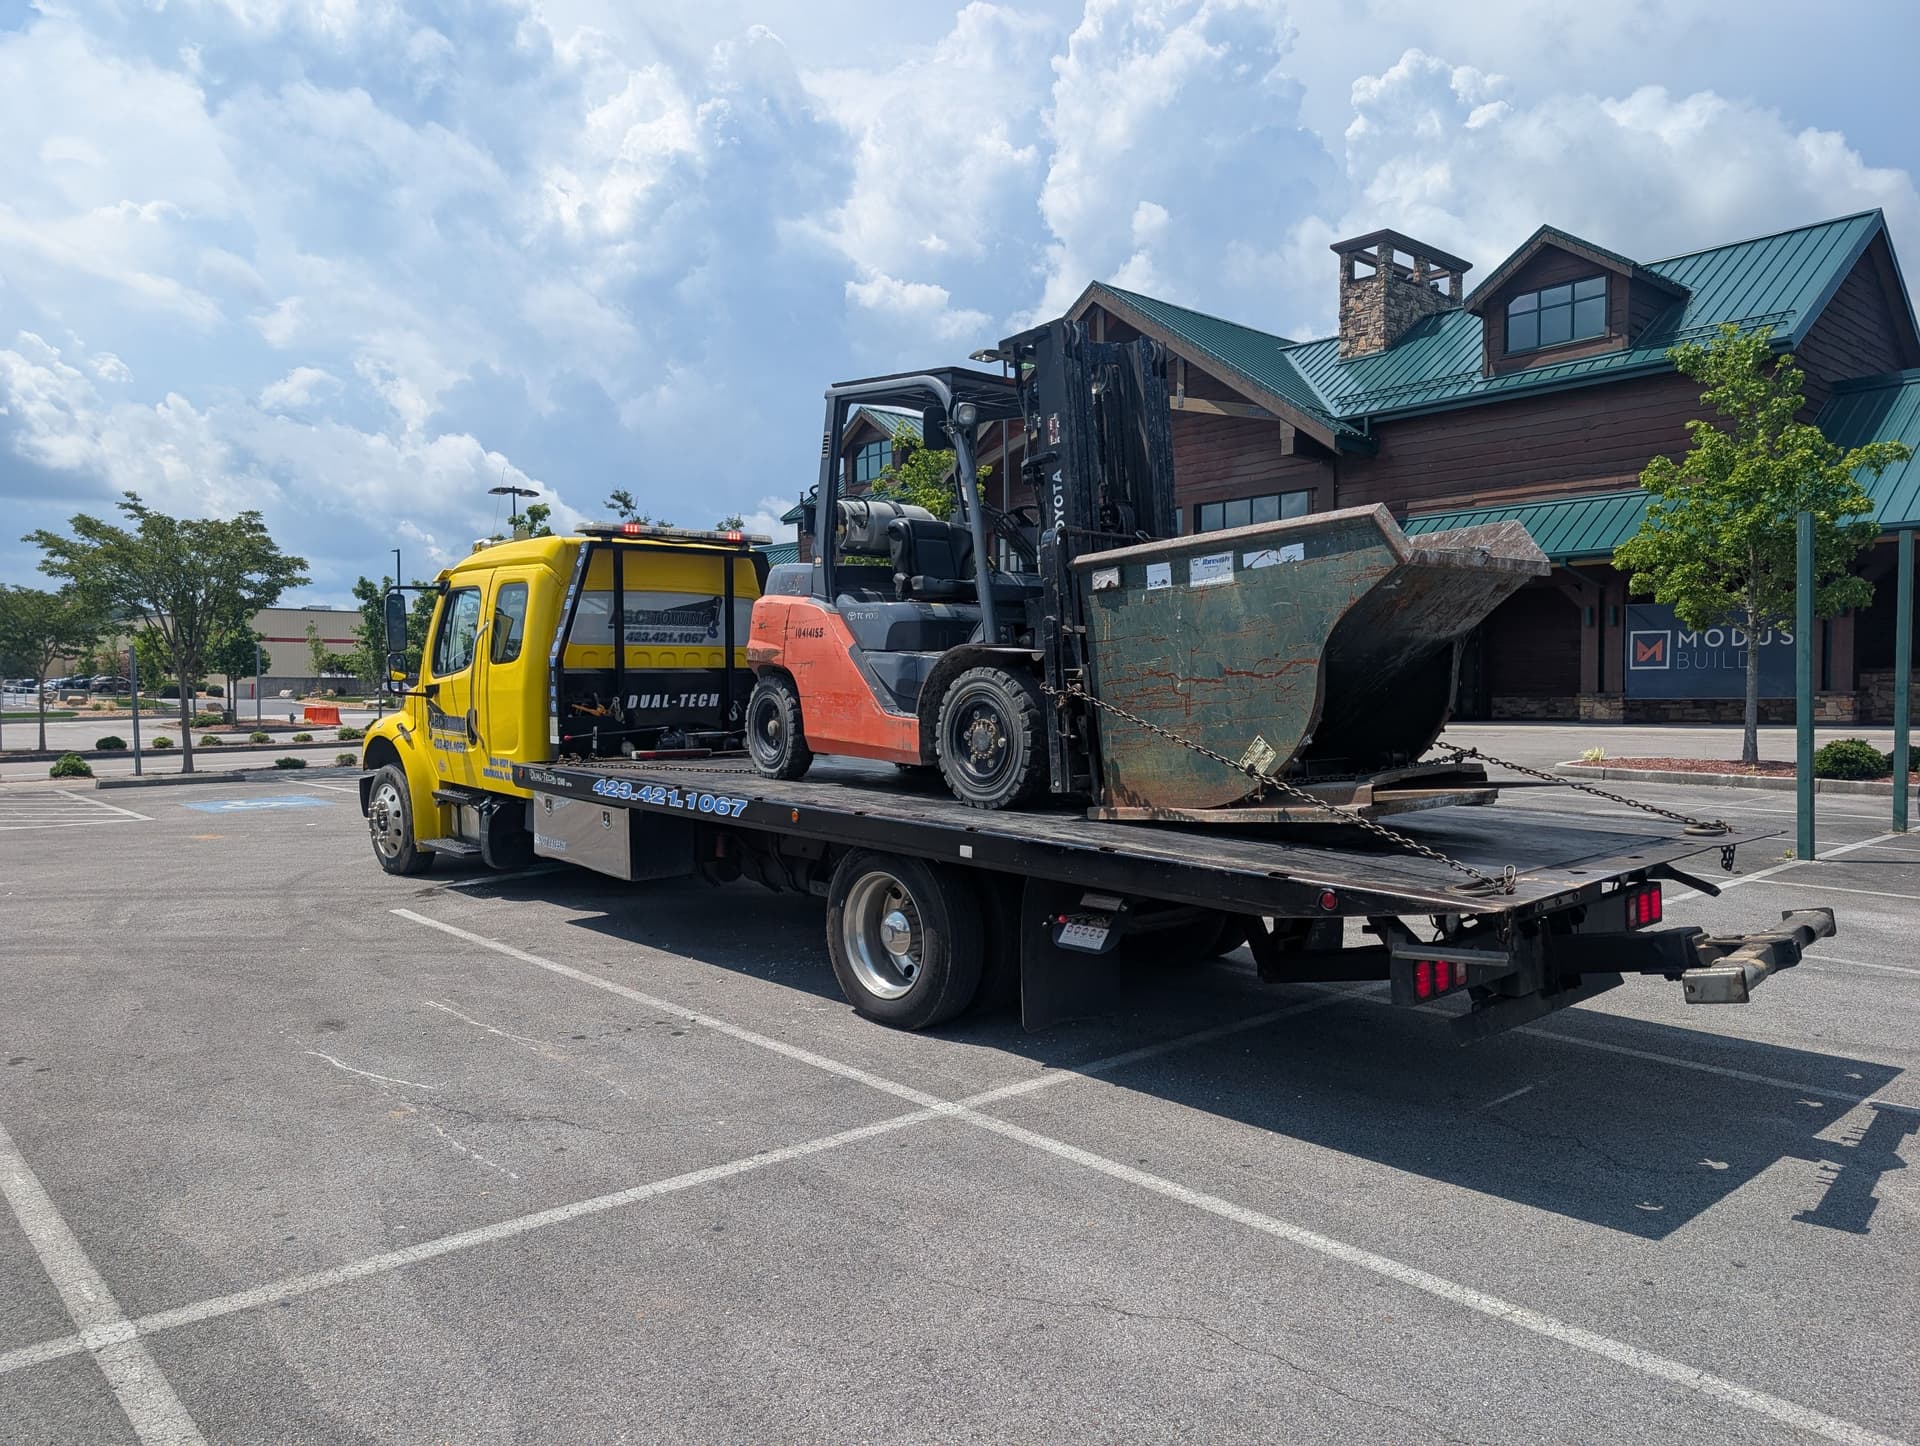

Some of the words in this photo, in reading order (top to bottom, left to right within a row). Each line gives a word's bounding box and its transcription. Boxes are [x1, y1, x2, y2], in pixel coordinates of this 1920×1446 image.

[625, 631, 707, 644] 423.421.1067
[1677, 627, 1795, 649] MODUS
[627, 693, 720, 709] DUAL-TECH
[592, 778, 748, 818] 423.421.1067
